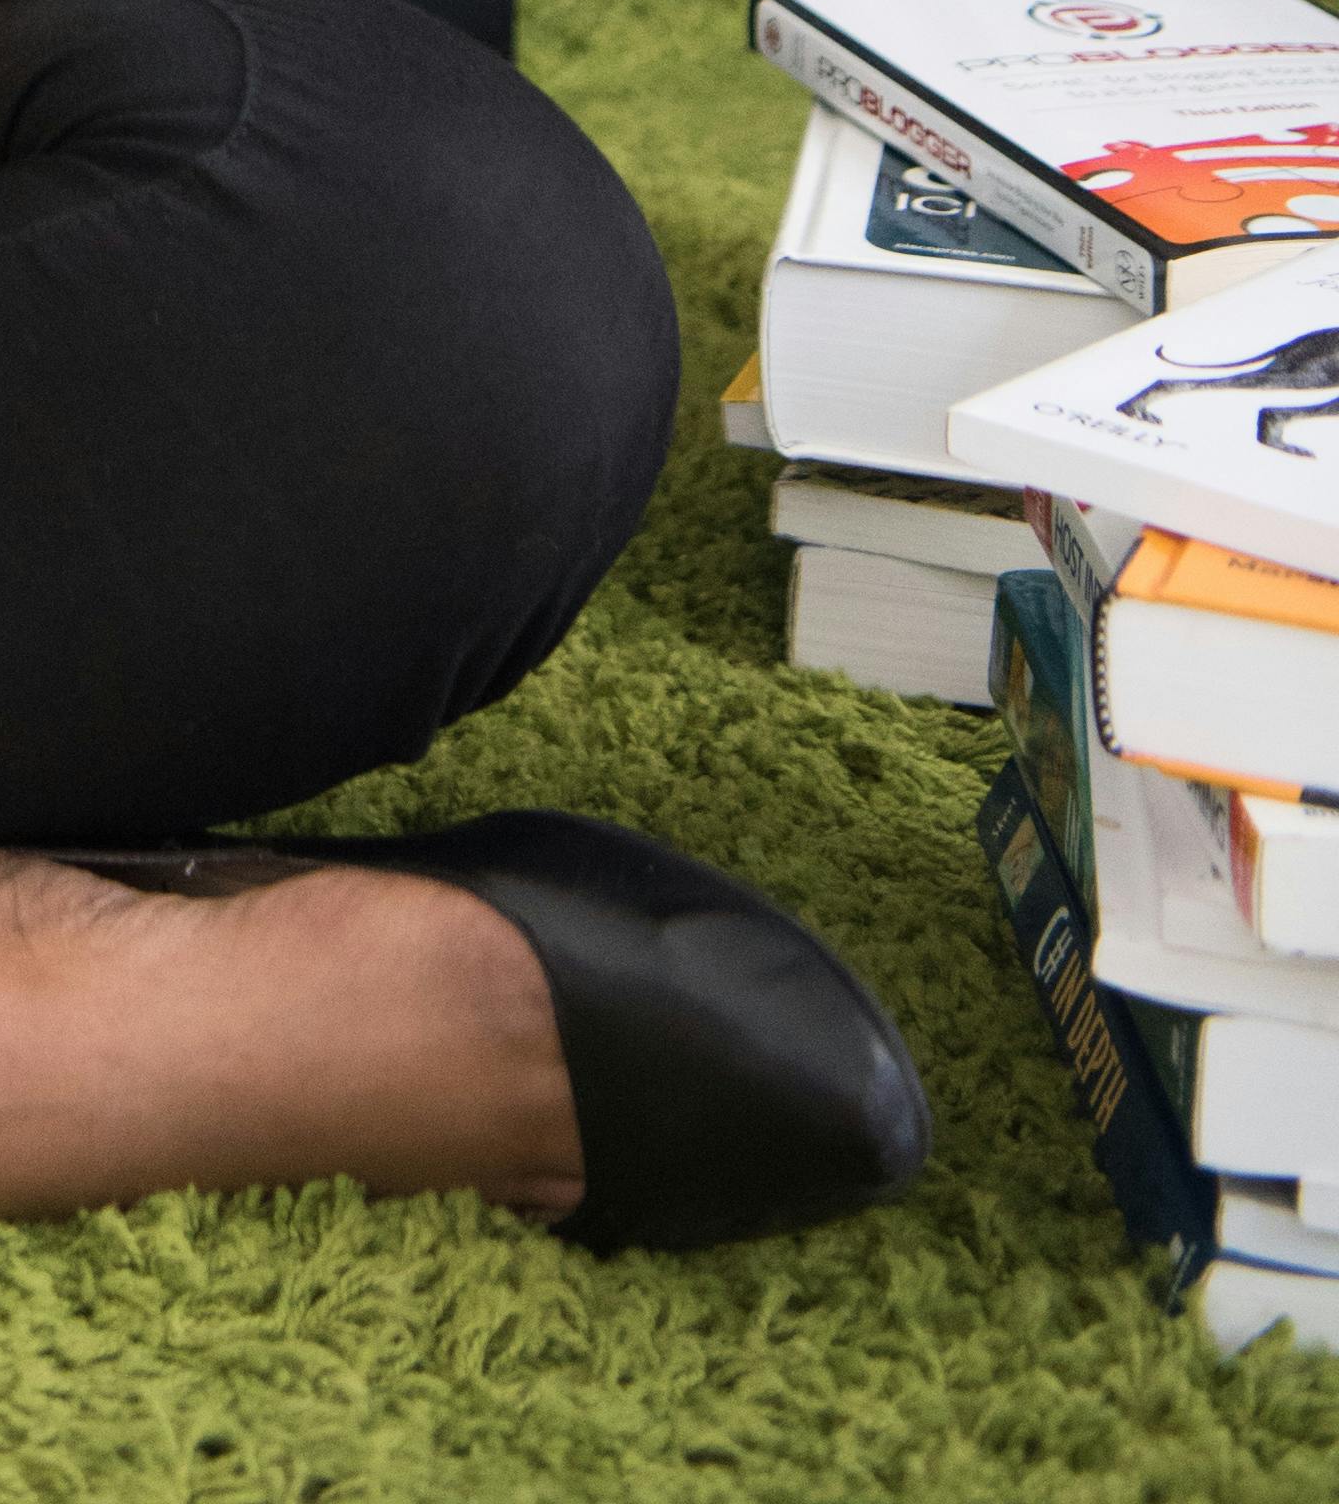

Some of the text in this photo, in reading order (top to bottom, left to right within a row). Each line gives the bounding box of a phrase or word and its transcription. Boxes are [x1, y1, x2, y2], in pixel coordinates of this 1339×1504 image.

[815, 54, 974, 180] PROBLOGGER
[1048, 962, 1092, 1029] IN
[1068, 990, 1131, 1135] DEPTH
